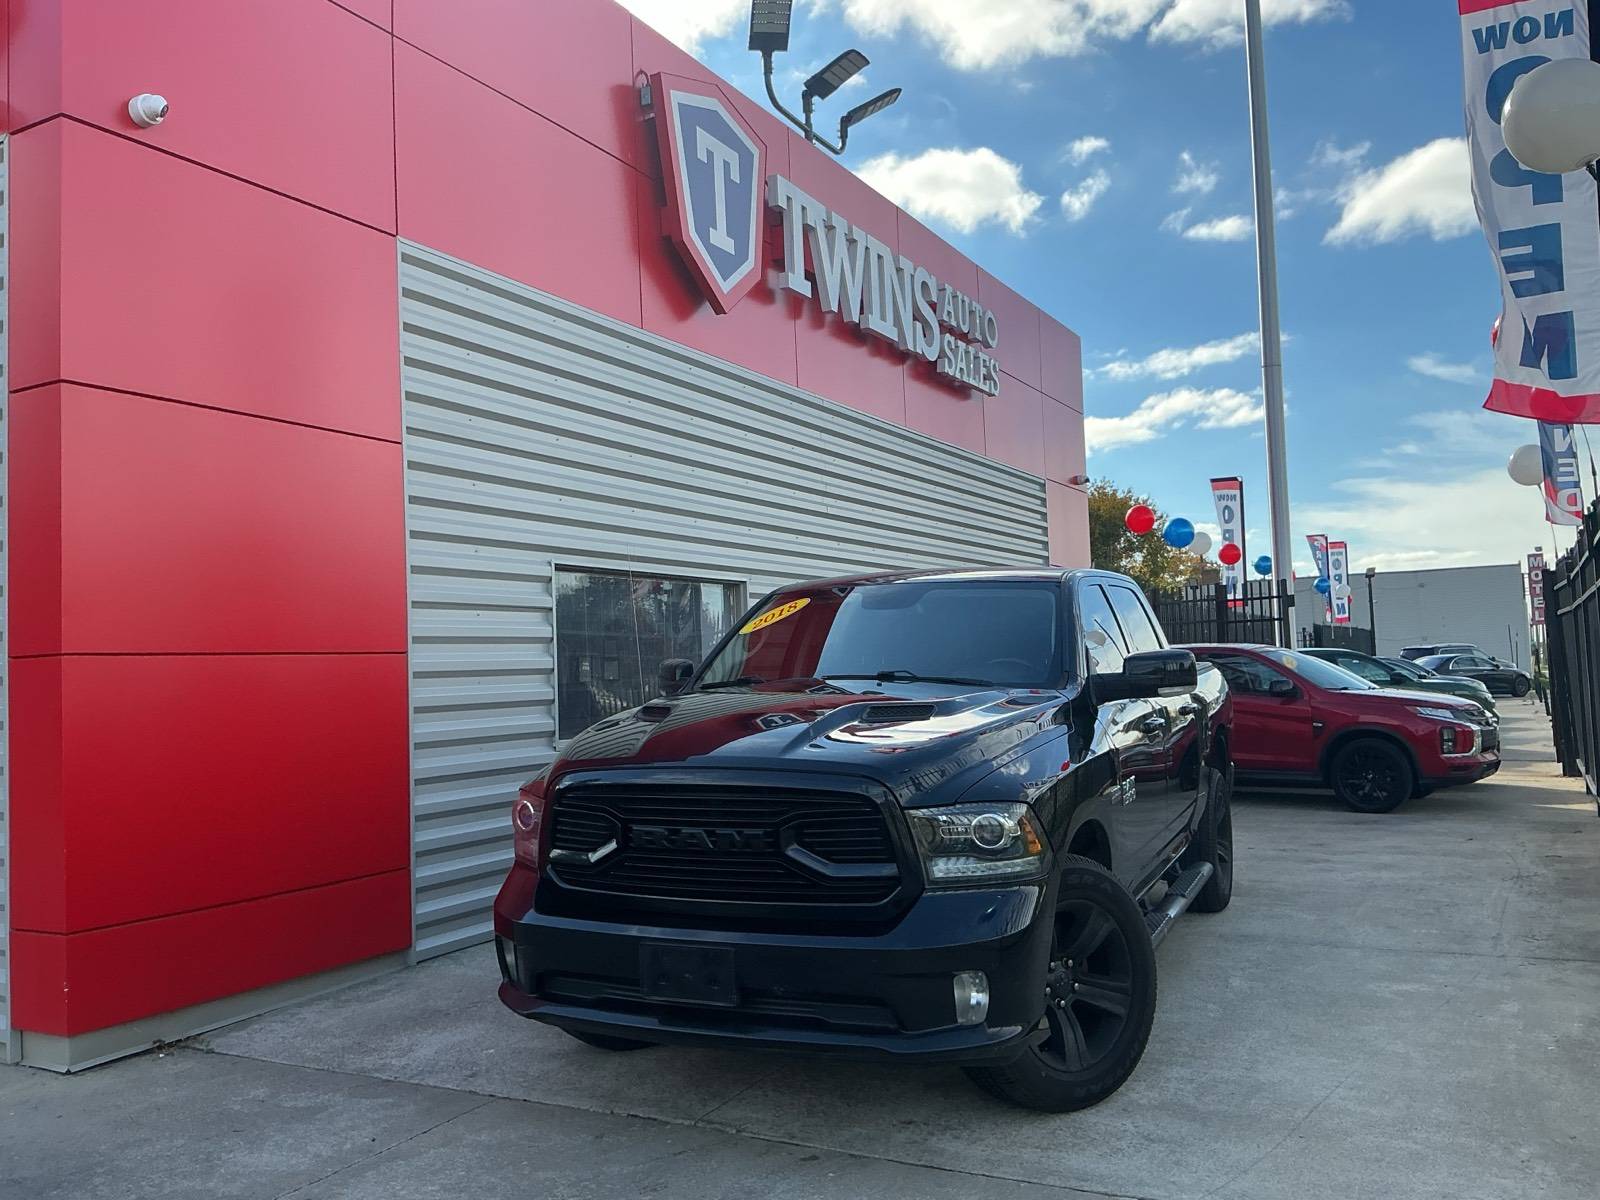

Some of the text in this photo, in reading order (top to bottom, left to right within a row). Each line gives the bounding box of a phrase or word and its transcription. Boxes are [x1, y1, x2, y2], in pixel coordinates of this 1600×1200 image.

[696, 125, 740, 256] T
[768, 173, 941, 362] TWINS
[941, 283, 998, 349] AUTO
[941, 333, 1000, 396] SALES
[752, 601, 798, 629] 2018
[1529, 556, 1545, 621] MOTEL
